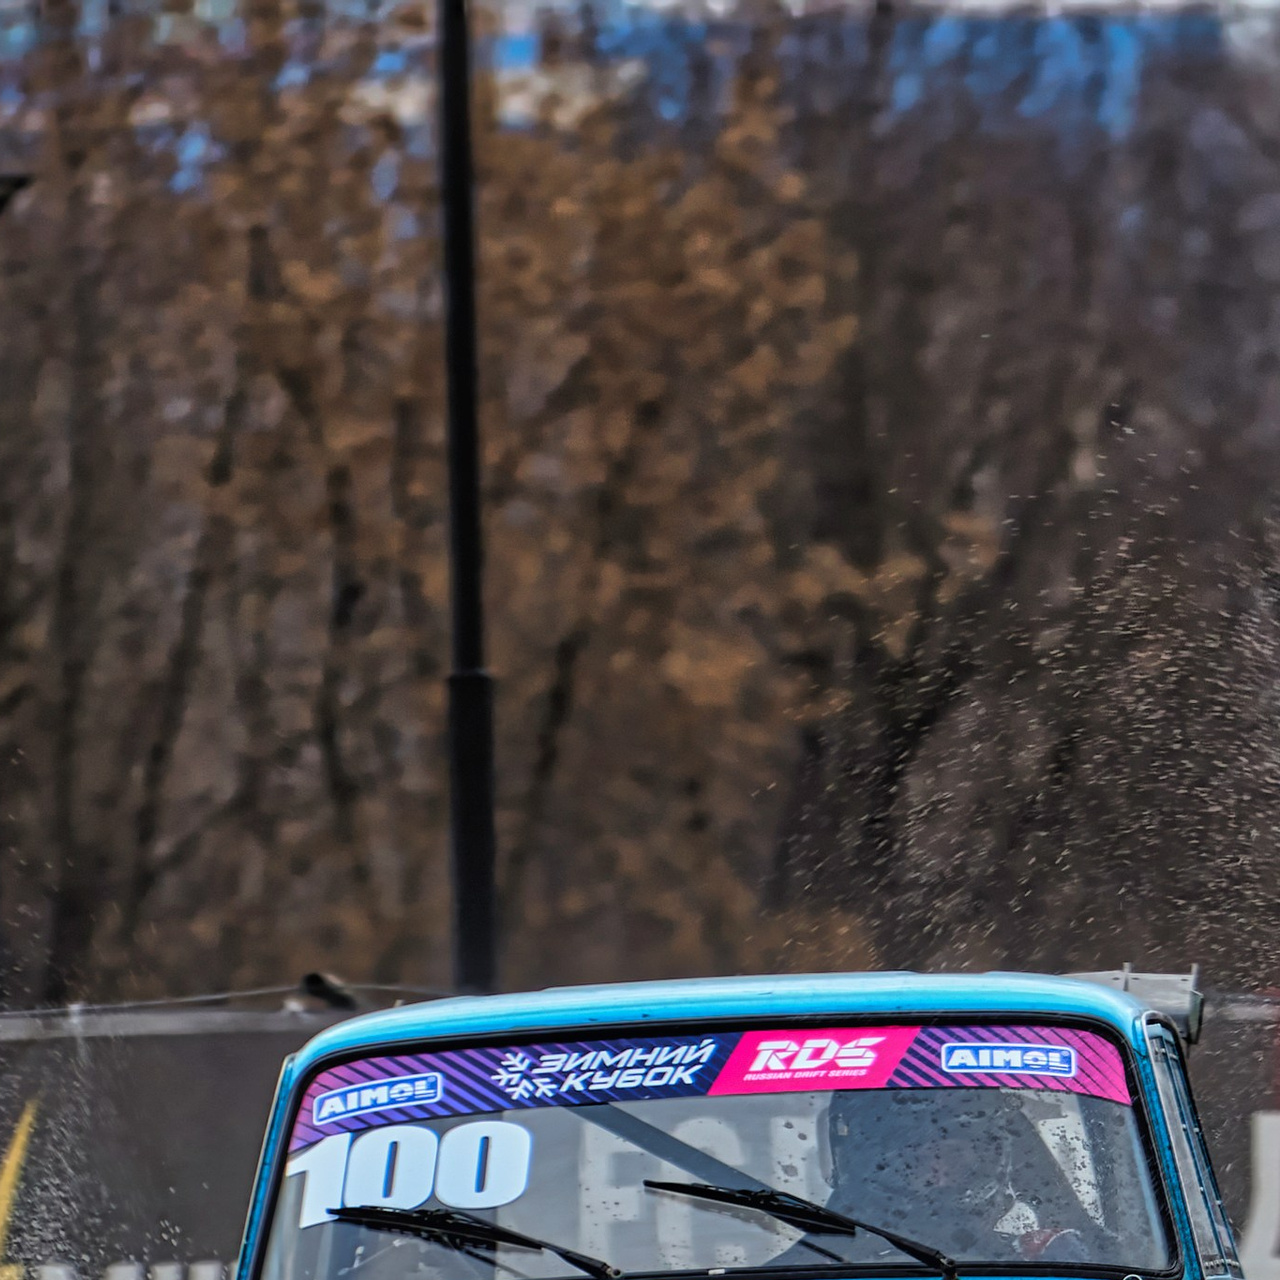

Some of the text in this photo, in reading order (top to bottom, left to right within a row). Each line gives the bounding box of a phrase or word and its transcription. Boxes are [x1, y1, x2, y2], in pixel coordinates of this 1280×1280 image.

[532, 1039, 716, 1075] ЗИМНИЙ
[749, 1037, 886, 1072] RDS
[948, 1049, 1070, 1072] AIMOL
[560, 1065, 703, 1092] КУБОК
[743, 1069, 868, 1081] RUSSIAN DRIFT SERIES
[318, 1079, 436, 1120] AIMOL
[286, 1120, 531, 1229] 100
